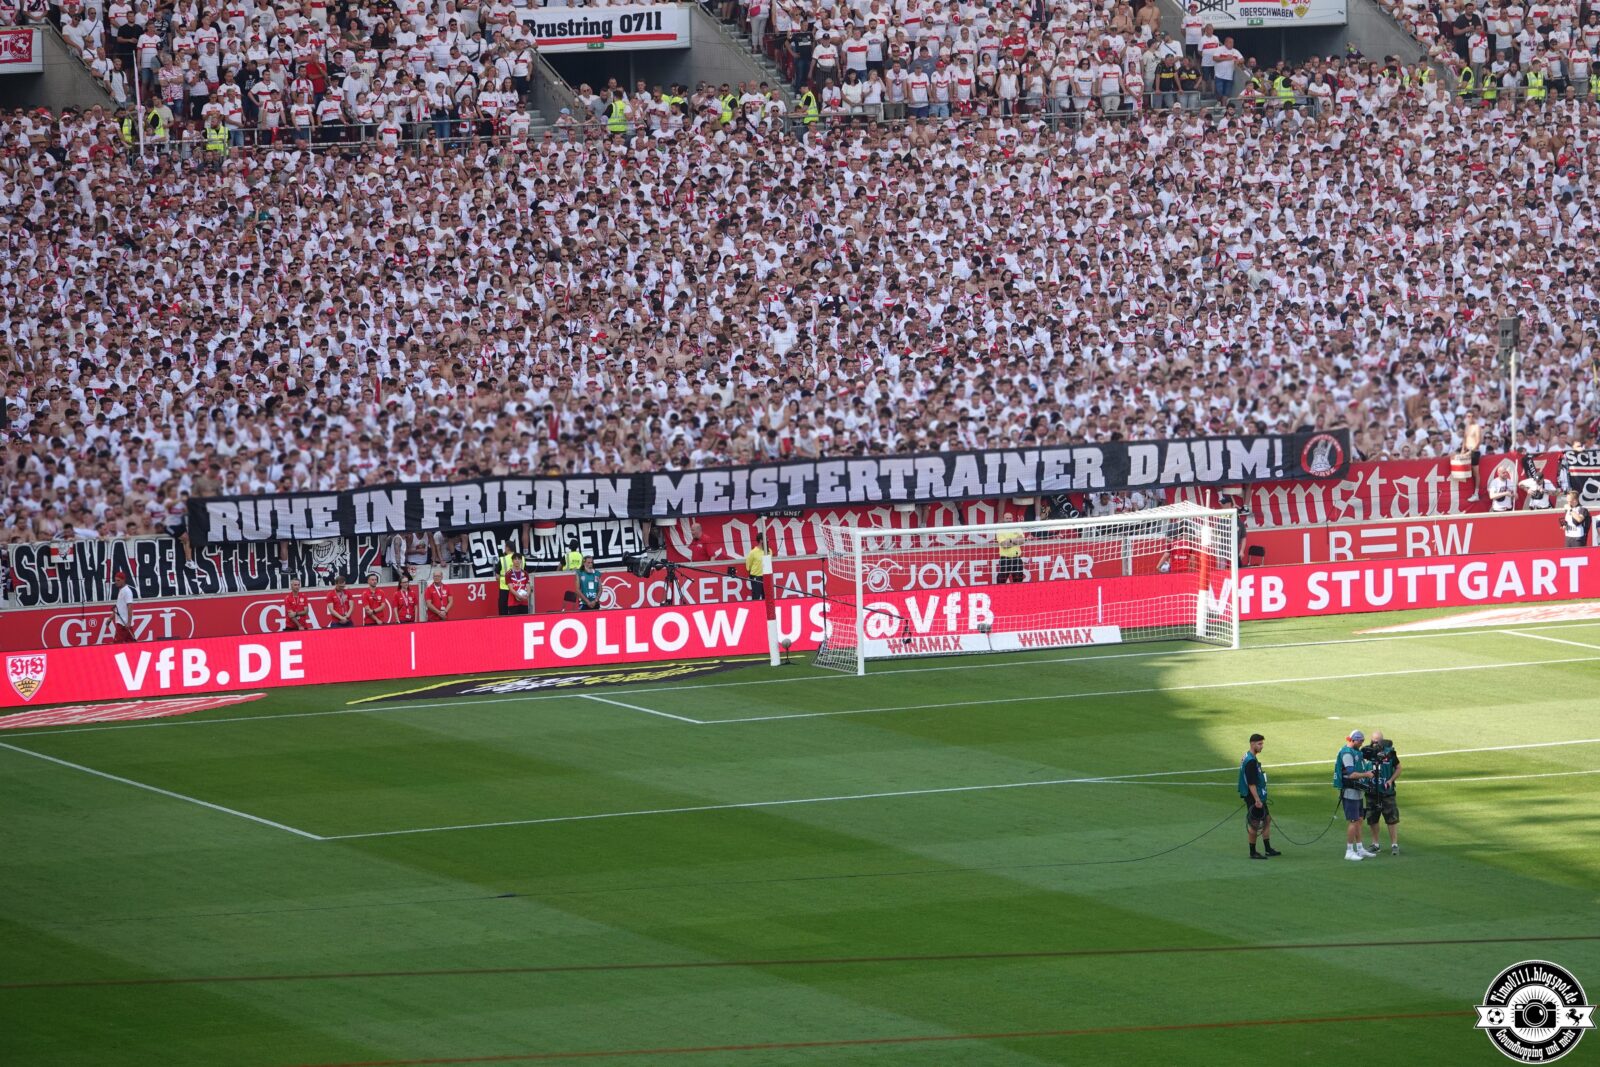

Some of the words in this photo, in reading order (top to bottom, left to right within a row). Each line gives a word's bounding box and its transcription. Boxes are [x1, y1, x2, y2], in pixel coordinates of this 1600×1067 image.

[523, 17, 613, 39] Brustring
[620, 11, 661, 33] 0711
[1240, 7, 1294, 18] OBERSCHWABEN
[207, 496, 342, 543] RUHE
[353, 489, 408, 535] IN
[420, 477, 632, 529] FRIEDEN
[653, 447, 1104, 517] MEISTERTRAINER
[1127, 438, 1285, 486] DAUM!
[530, 518, 645, 560] UMSETZEN
[467, 583, 487, 602] 34
[1208, 575, 1287, 615] VfB
[1307, 556, 1589, 611] STUTTGART
[523, 607, 749, 661] FOLLOW
[776, 602, 832, 643] US
[865, 591, 995, 640] @VfB
[886, 635, 964, 655] WINAMAX
[1017, 628, 1095, 647] WINAMAX
[114, 639, 306, 692] VfB.DE
